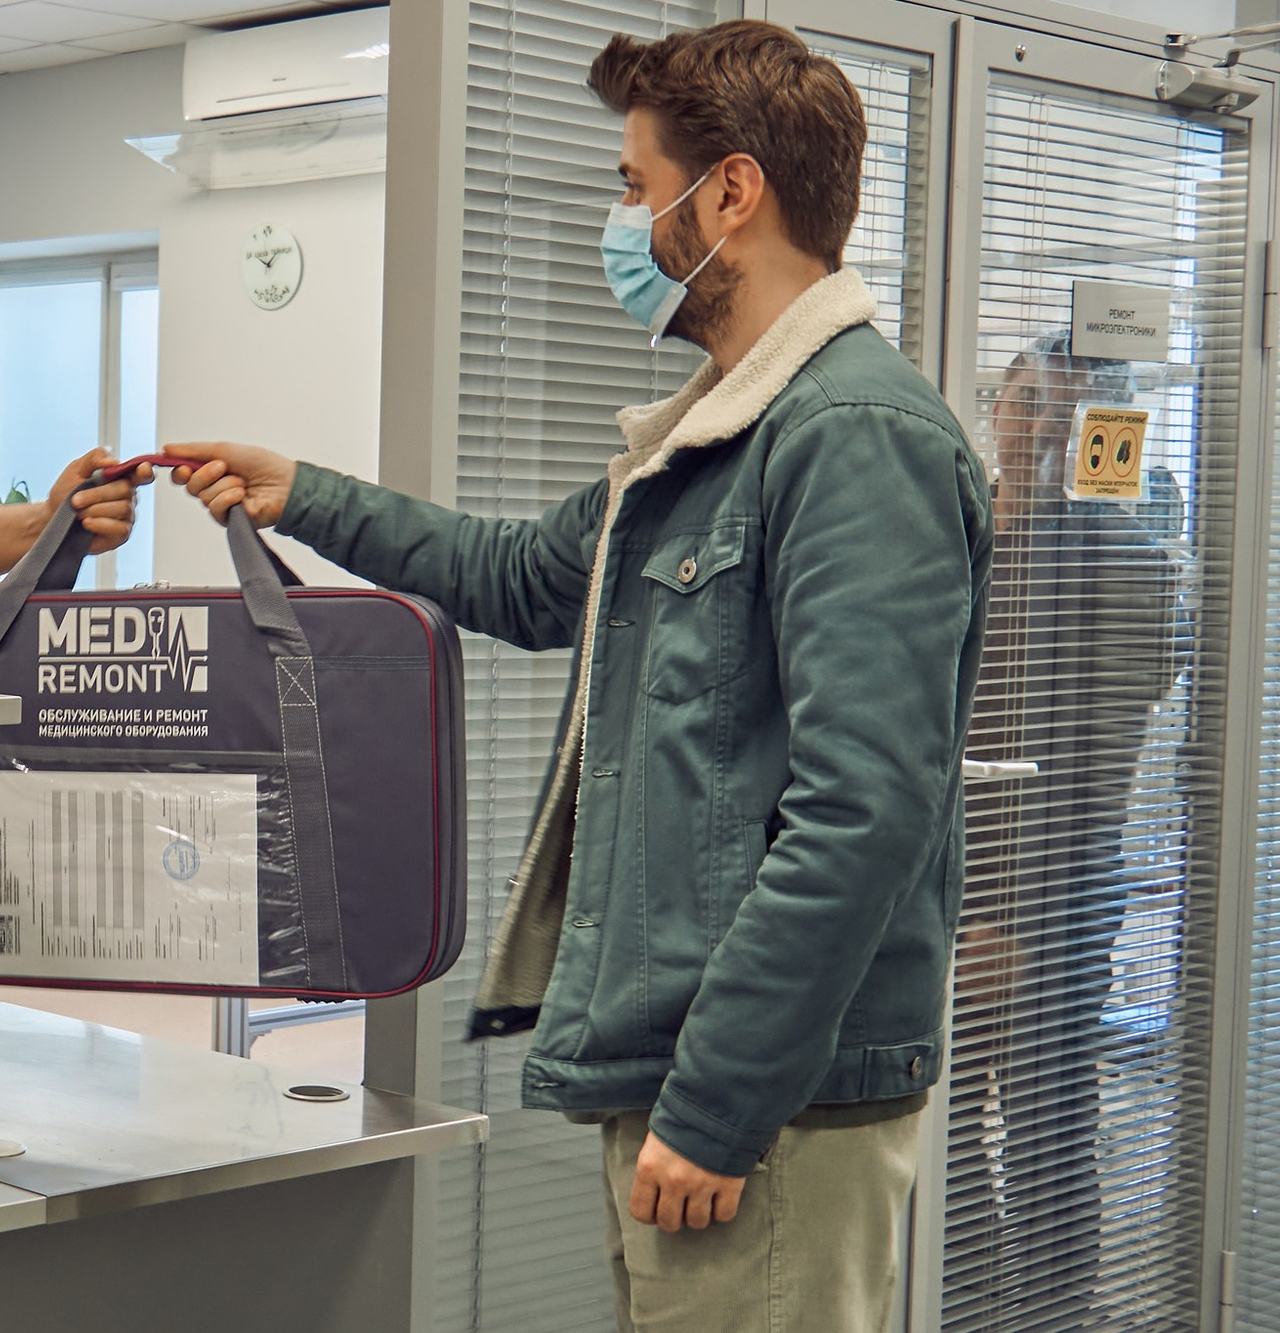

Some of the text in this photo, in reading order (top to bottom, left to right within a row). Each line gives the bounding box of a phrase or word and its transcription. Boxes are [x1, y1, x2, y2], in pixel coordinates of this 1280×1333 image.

[1109, 309, 1135, 320] РЕМОНТ
[38, 664, 167, 694] REMONT
[38, 708, 208, 723] ОБСЛУЖИВАНИЕ И РЕМОНТ
[38, 724, 209, 739] МЕДИЦИНСКОГО ОБОРУДОВАНИЯ
